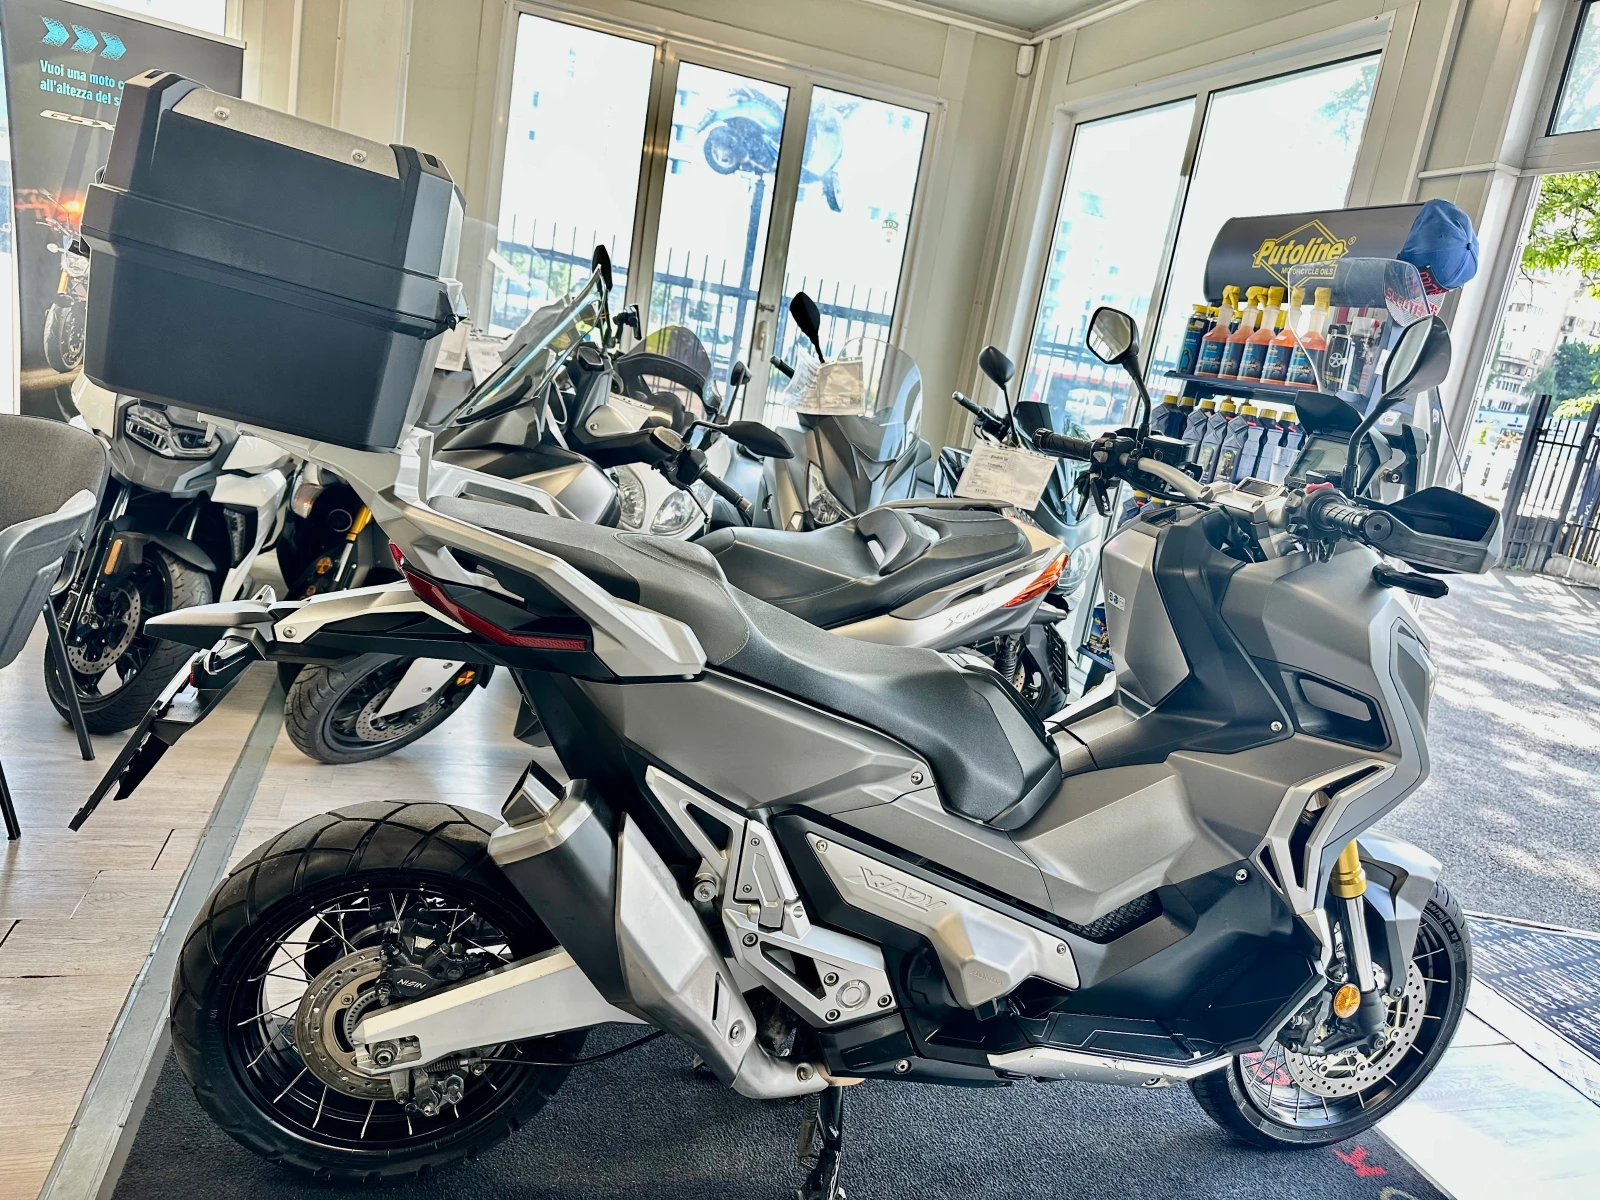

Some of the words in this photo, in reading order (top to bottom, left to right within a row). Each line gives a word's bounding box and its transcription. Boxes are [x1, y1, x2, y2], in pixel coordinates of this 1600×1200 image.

[40, 60, 64, 76] Vuoi
[67, 68, 87, 81] una
[89, 73, 115, 88] moto
[40, 78, 93, 100] all'altezza
[96, 90, 111, 104] del
[1254, 238, 1344, 266] Putoline
[1320, 267, 1334, 276] OILS
